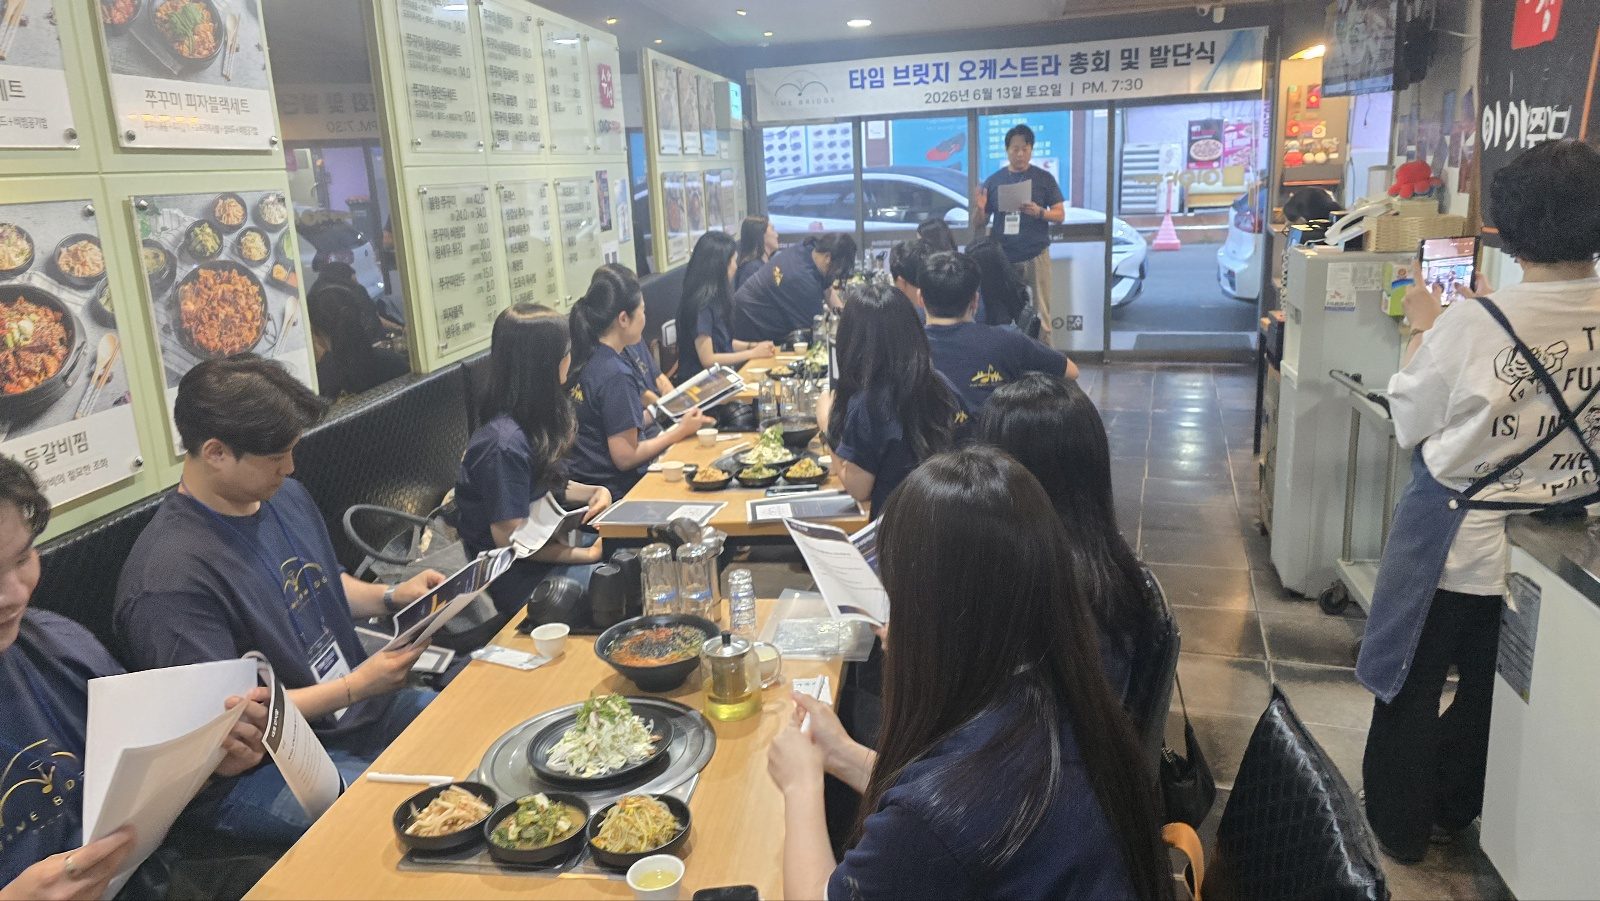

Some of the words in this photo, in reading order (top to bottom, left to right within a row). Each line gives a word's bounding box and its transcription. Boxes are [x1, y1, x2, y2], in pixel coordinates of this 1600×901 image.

[848, 66, 885, 90] 타임
[893, 61, 950, 86] 브릿지
[958, 54, 1062, 82] 오케스트라
[1068, 50, 1111, 75] 총회
[1120, 47, 1140, 71] 및
[1150, 40, 1216, 69] 발단식
[144, 89, 183, 111] 쭈꾸미
[184, 93, 251, 116] 피자블랙세트
[924, 88, 970, 104] 2026년
[973, 87, 993, 101] 6월
[996, 85, 1022, 99] 13일
[1026, 83, 1062, 98] 토요일
[1082, 81, 1108, 94] PM.
[1112, 77, 1143, 92] 7:30
[1563, 366, 1600, 391] FU
[24, 431, 89, 472] 등갈비찜
[1549, 452, 1591, 471] THE
